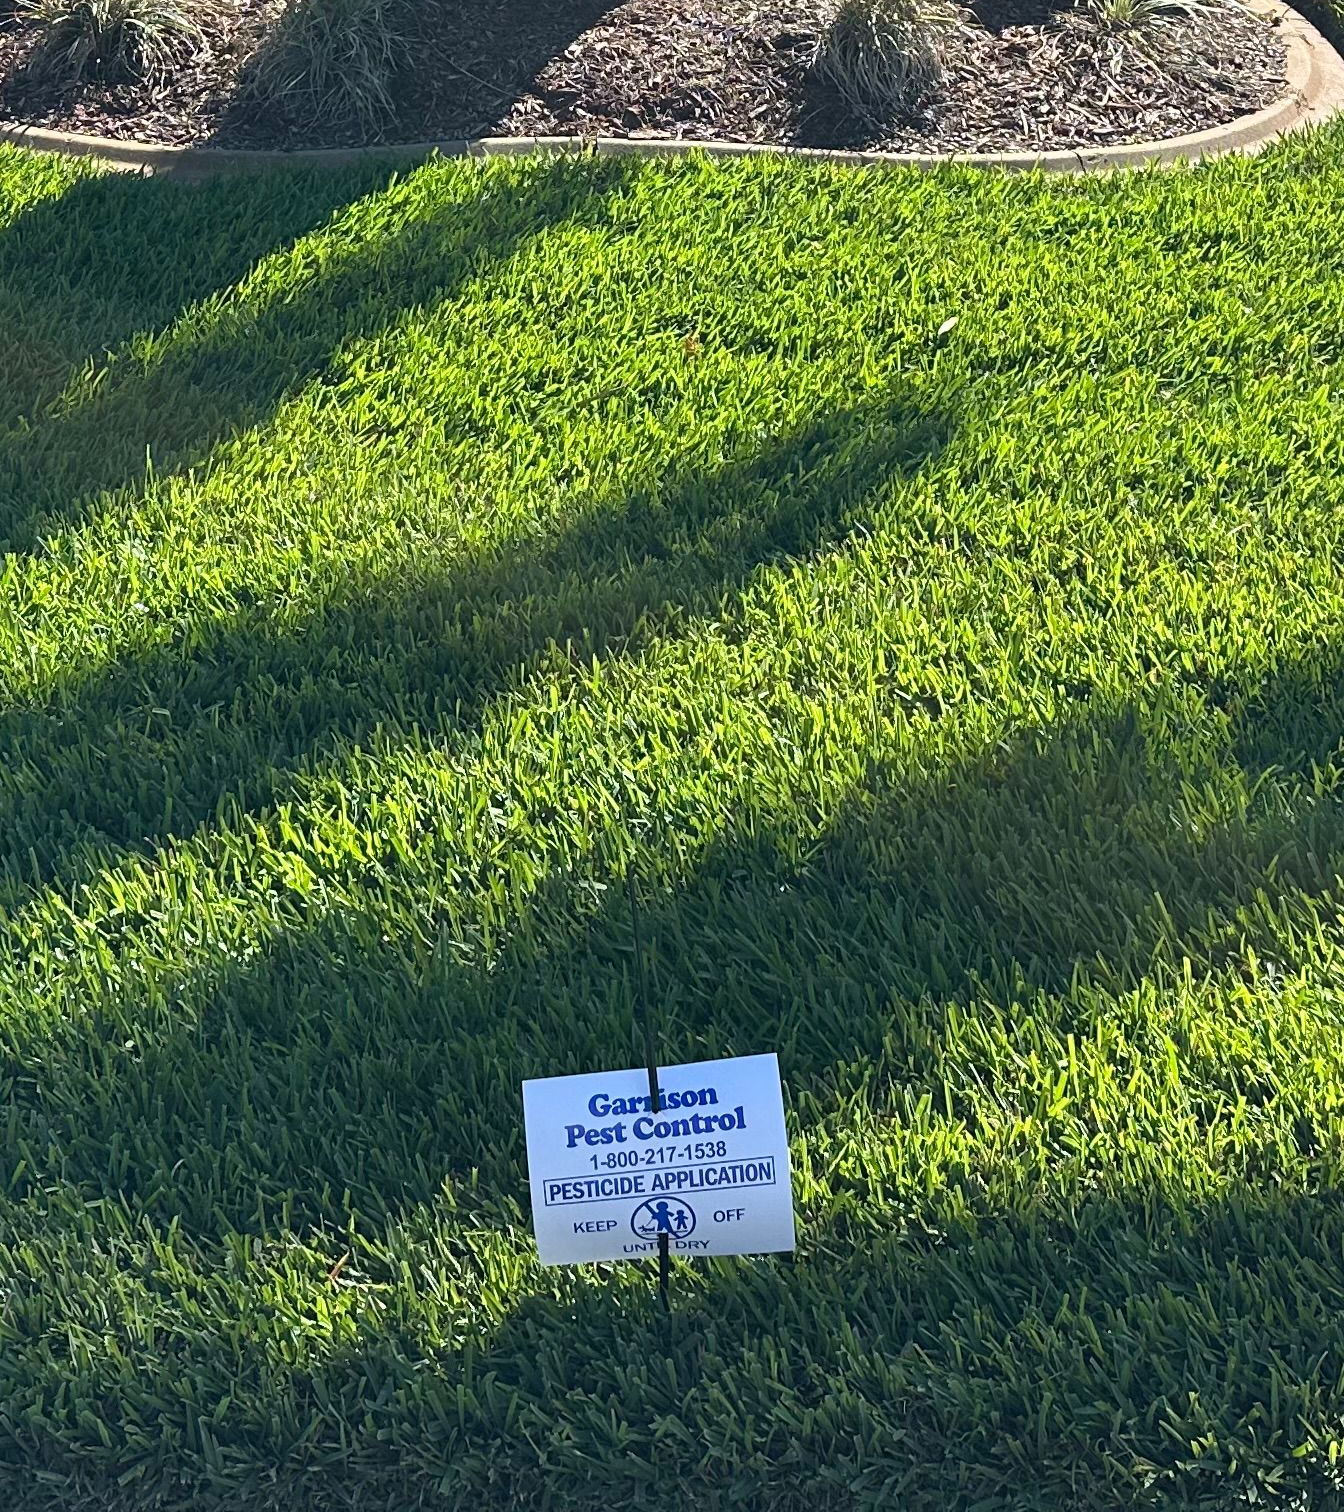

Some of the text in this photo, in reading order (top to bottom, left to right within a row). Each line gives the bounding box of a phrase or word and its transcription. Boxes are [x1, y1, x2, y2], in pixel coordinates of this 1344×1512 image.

[564, 1105, 747, 1148] Pest Control
[589, 1140, 727, 1170] 1-800-217-1538
[549, 1161, 772, 1202] PESTICIDE APPLICATION
[573, 1207, 746, 1234] KEEP OFF
[675, 1239, 711, 1250] DRY
